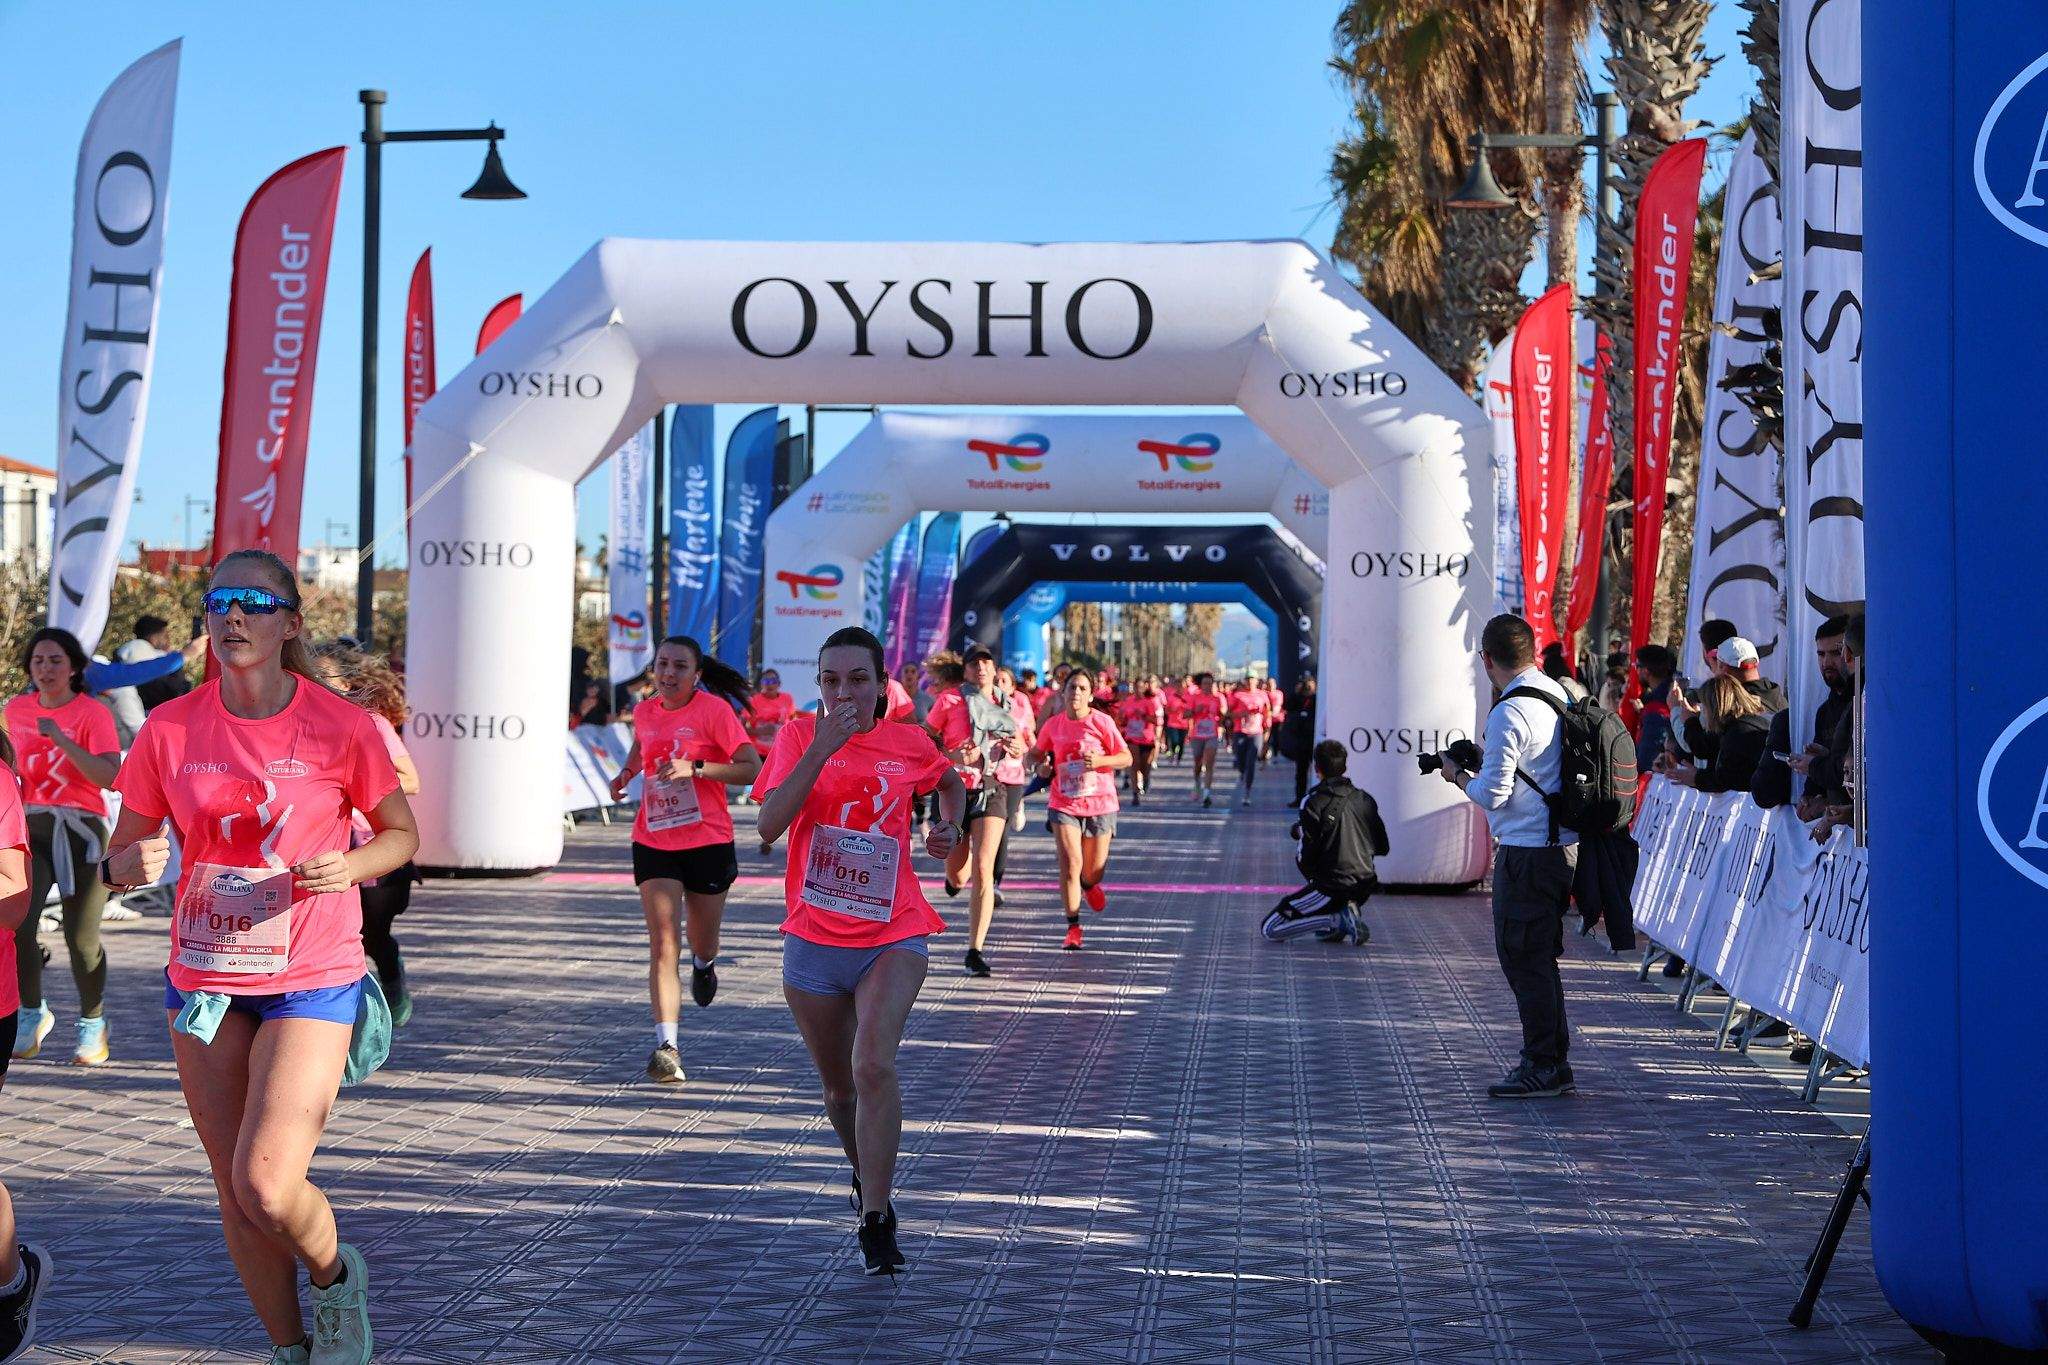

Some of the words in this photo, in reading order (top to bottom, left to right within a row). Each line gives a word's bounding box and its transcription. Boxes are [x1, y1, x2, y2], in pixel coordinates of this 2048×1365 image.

[731, 277, 1153, 361] OYSHO
[256, 223, 312, 464] Santander
[479, 371, 603, 399] OYSHO
[1280, 371, 1408, 398] OYSHO
[967, 479, 1051, 491] TotalEnergies
[1137, 479, 1221, 491] TotalEnergies
[419, 540, 533, 568] OYSHO
[1050, 544, 1227, 562] VOLVO
[1350, 551, 1469, 578] OYSHO
[774, 606, 844, 617] TotalEnergies
[412, 712, 525, 740] OYSHO
[1350, 727, 1467, 754] OYSHO
[183, 762, 229, 774] OYSHO
[835, 866, 871, 884] 016
[809, 893, 837, 907] OYSHO
[208, 913, 253, 932] 016
[215, 935, 237, 944] 3888
[184, 952, 215, 965] OYSHO
[222, 946, 242, 954] MUJER
[237, 959, 274, 967] Santander
